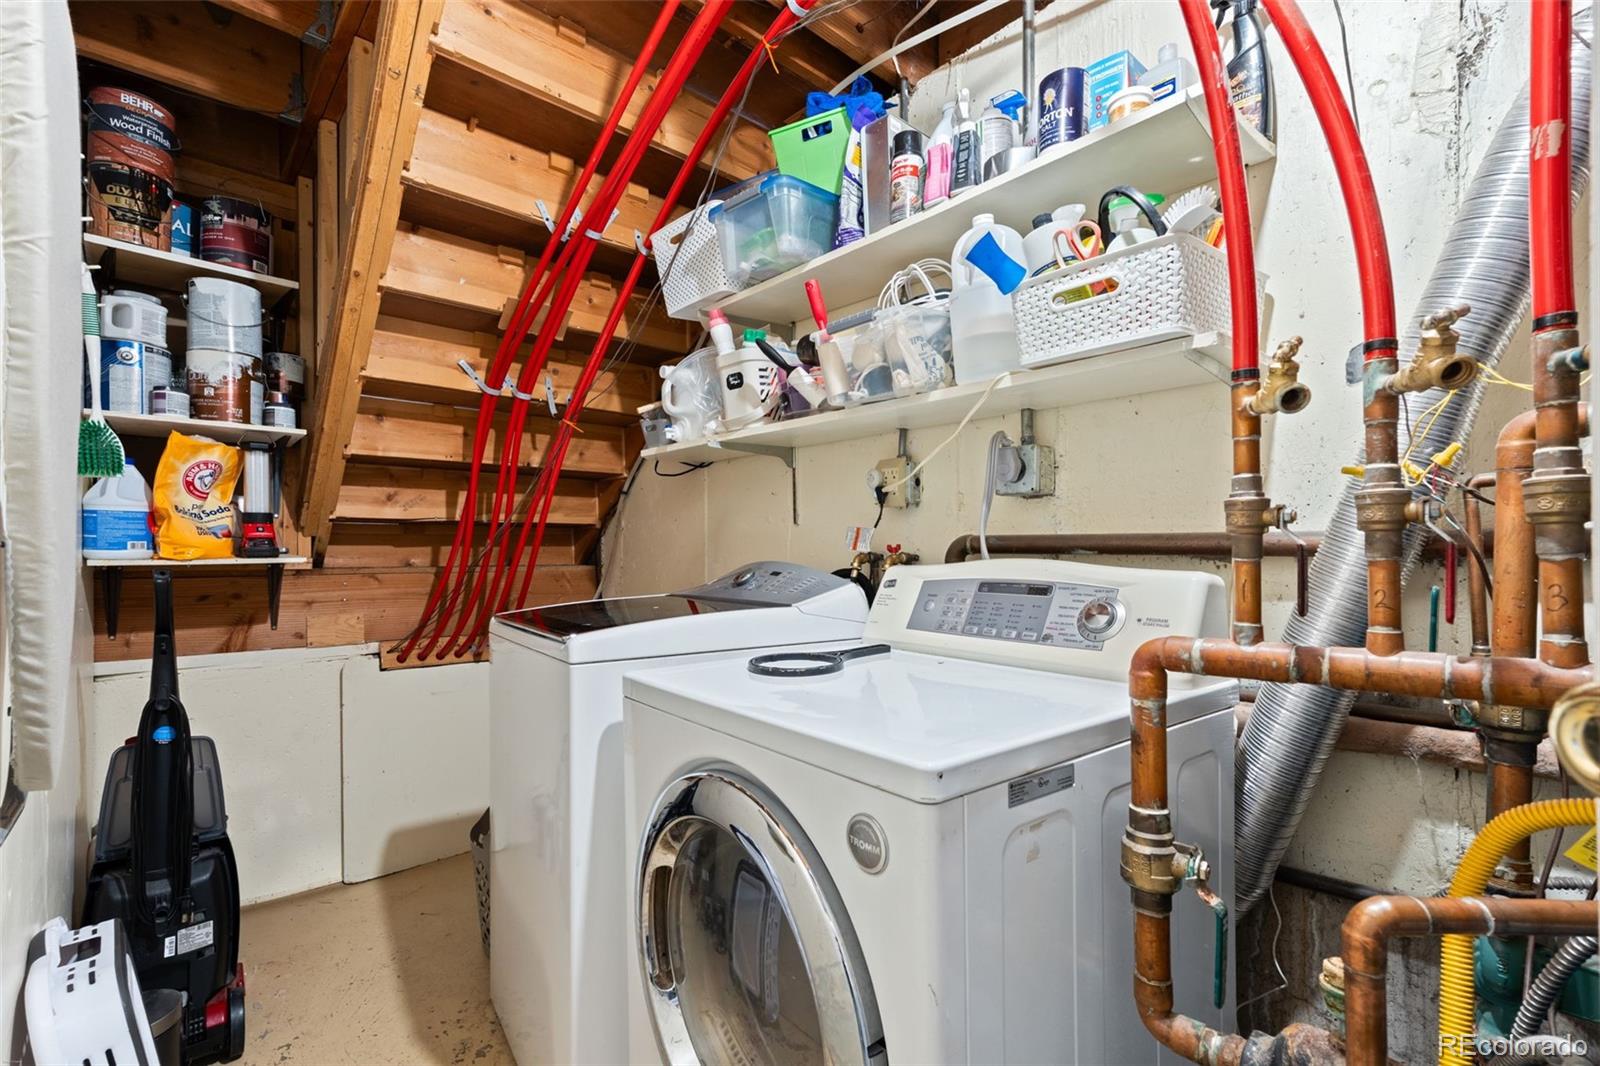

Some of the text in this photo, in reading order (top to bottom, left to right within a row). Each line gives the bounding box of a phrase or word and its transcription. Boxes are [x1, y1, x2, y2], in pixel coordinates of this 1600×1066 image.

[120, 92, 154, 113] BEHR
[109, 117, 143, 134] Wood
[146, 129, 171, 150] Finish
[186, 466, 200, 482] ARM
[202, 505, 231, 518] Soda
[1374, 589, 1395, 611] 2
[1547, 583, 1569, 612] 3
[849, 834, 881, 856] TROMM
